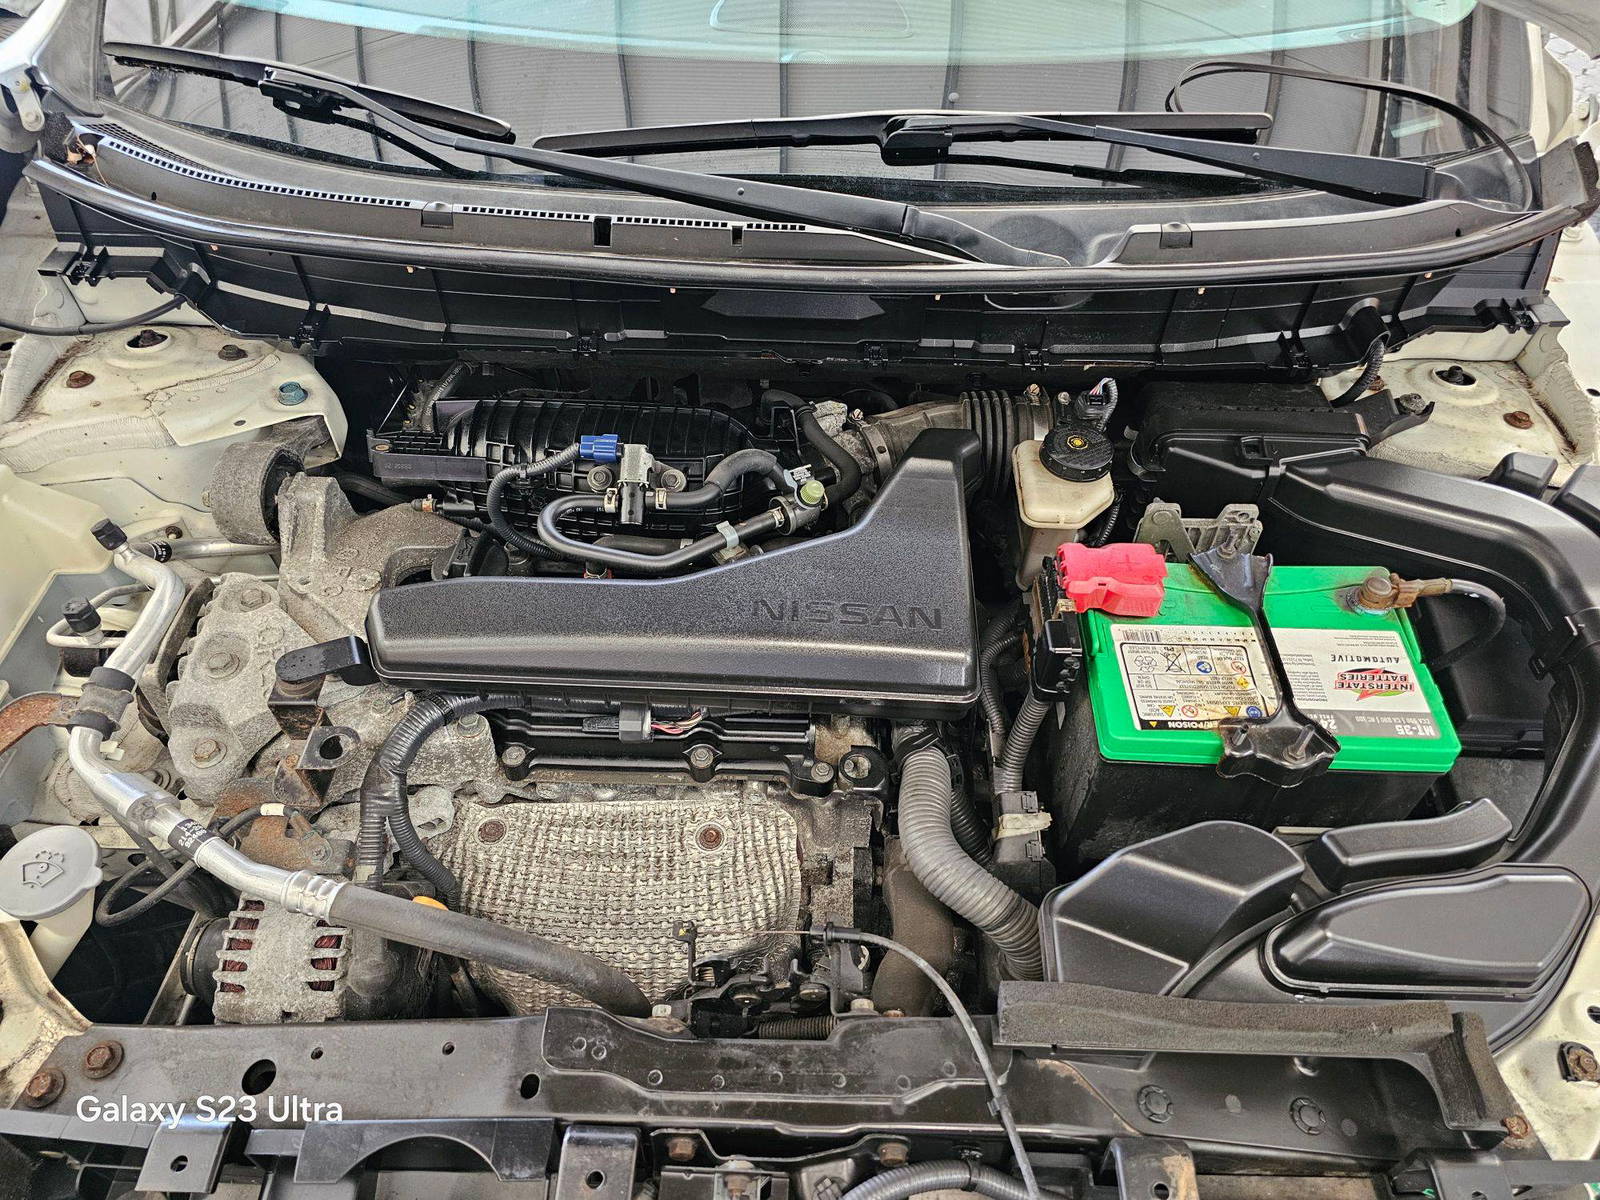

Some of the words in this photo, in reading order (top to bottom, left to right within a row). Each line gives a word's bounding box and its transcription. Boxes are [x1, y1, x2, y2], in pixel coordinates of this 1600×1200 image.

[751, 600, 943, 630] NISSAN
[1330, 654, 1400, 664] AUTOMOTIVE
[1339, 673, 1407, 682] BATTERIES
[1337, 681, 1413, 691] INTERSTATE
[1167, 721, 1219, 730] ER/POISON
[1395, 724, 1435, 736] MT-35
